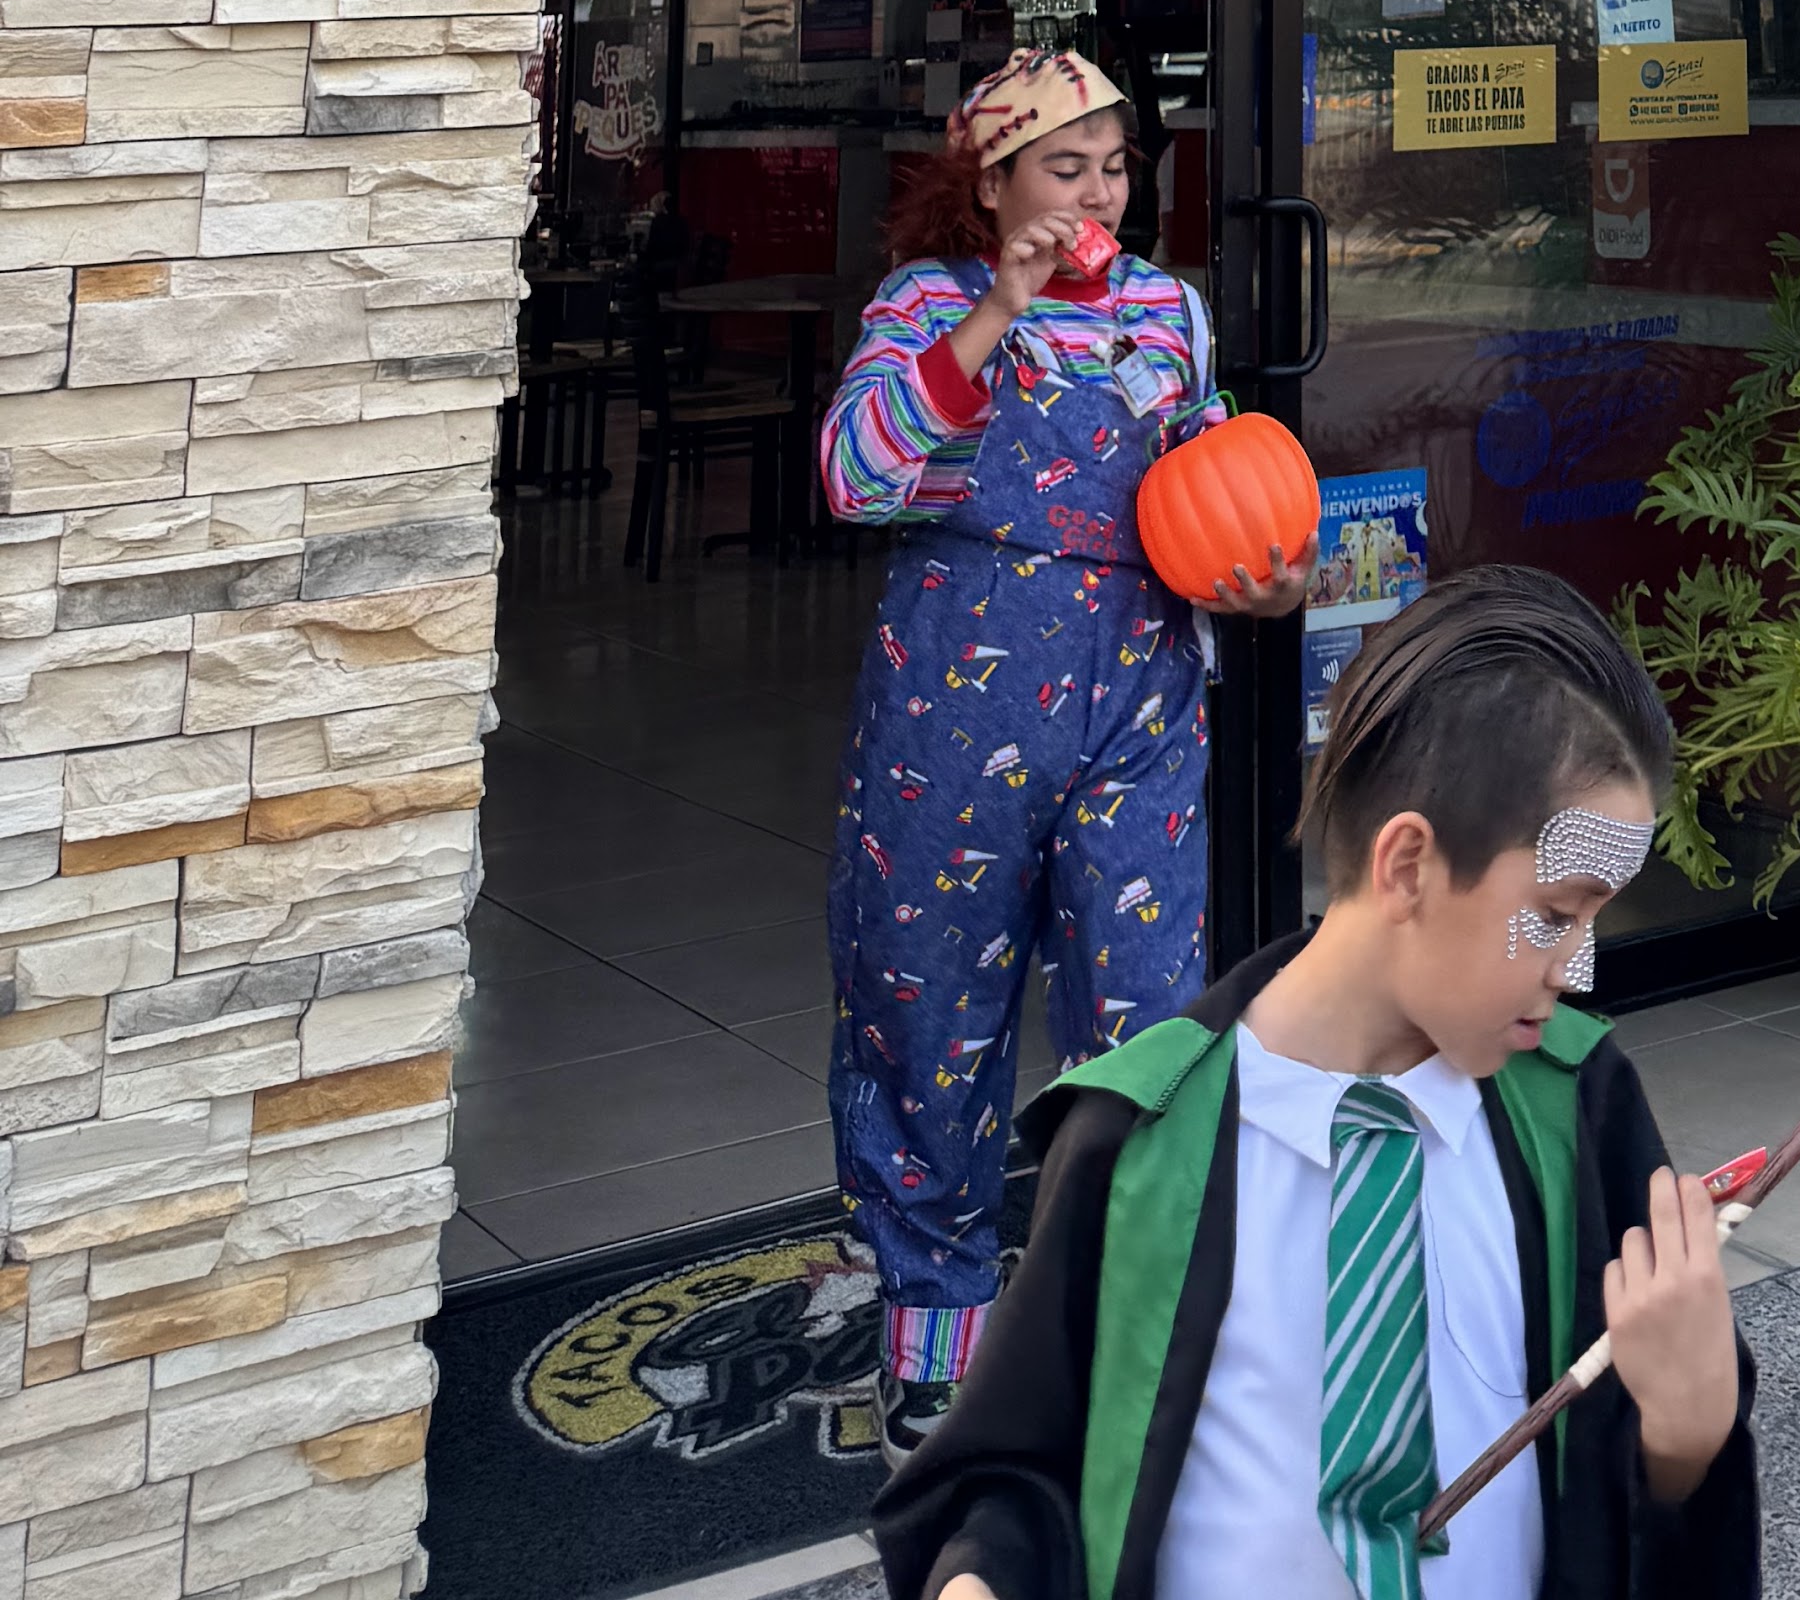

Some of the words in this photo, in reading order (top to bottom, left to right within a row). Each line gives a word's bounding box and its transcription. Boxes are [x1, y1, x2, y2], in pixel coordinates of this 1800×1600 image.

[1427, 64, 1478, 85] GRACIAS
[1482, 64, 1490, 83] A
[1427, 88, 1470, 114] TACOS
[1474, 87, 1488, 111] EL
[1492, 86, 1525, 111] PATA
[1427, 117, 1437, 134] TE
[1439, 117, 1464, 134] ABRE
[1466, 116, 1483, 132] LAS
[1485, 114, 1526, 132] PUERTAS
[1620, 226, 1643, 245] Food
[550, 1274, 755, 1408] TACOS
